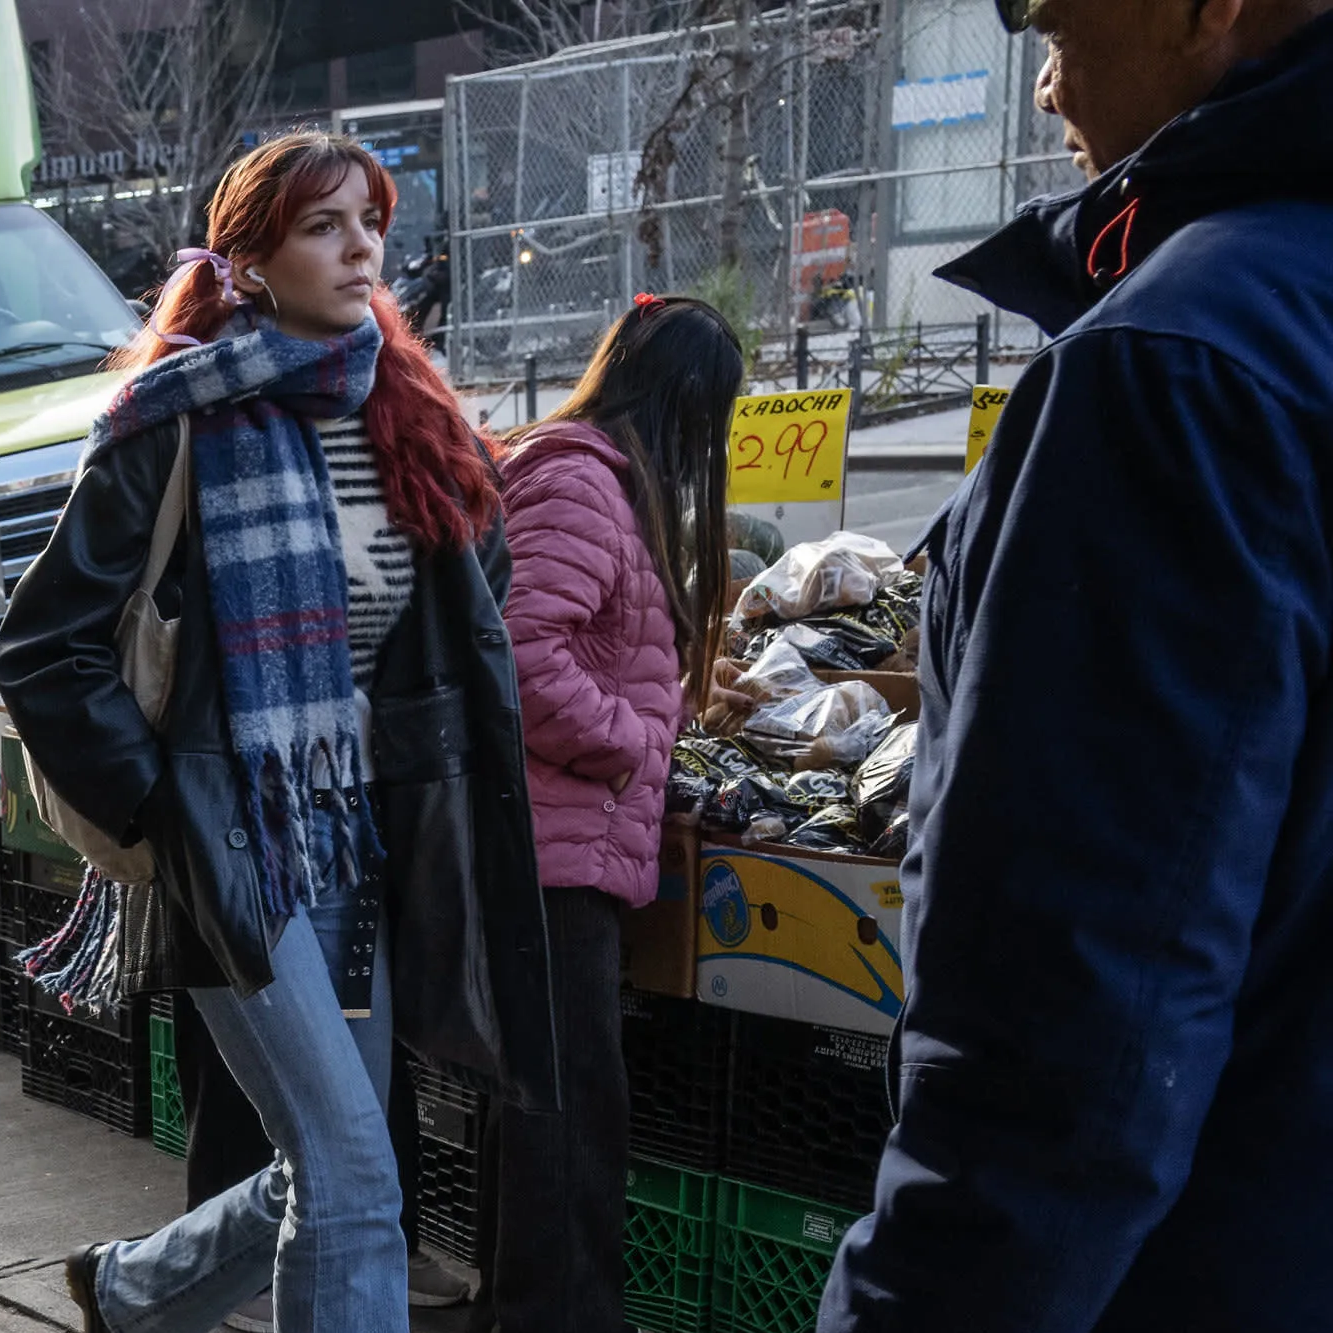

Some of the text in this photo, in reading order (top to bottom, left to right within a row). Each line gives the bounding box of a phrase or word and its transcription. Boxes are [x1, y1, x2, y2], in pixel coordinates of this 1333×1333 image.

[736, 393, 843, 418] KABOCHA
[735, 419, 828, 480] 2.99
[702, 871, 740, 908] Chiquita
